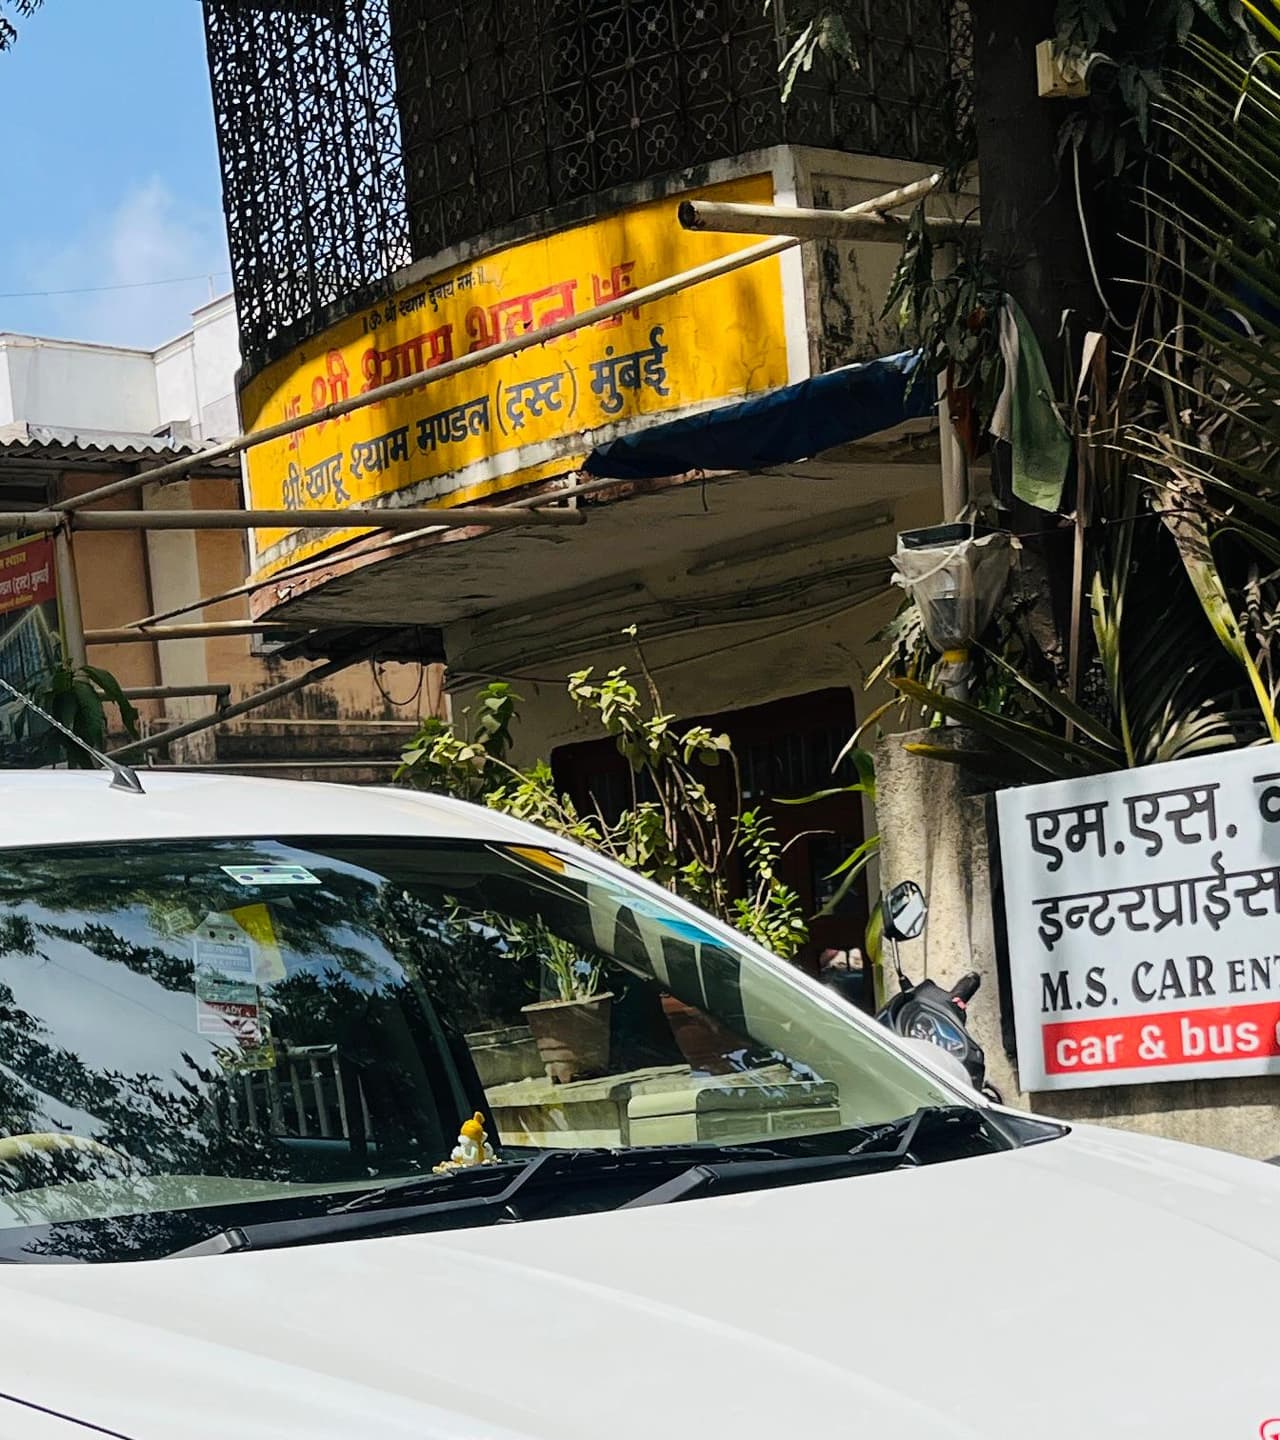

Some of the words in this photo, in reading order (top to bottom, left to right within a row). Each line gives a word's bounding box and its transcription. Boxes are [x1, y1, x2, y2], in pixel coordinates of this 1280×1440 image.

[350, 425, 410, 480] श्याम
[416, 395, 490, 451] मण्डल
[589, 326, 670, 415] मुंबई
[1040, 966, 1118, 1013] M.S.
[1131, 955, 1216, 1002] CAR
[1056, 1034, 1123, 1067] car
[1138, 1024, 1167, 1060] &
[1181, 1018, 1259, 1056] bus
